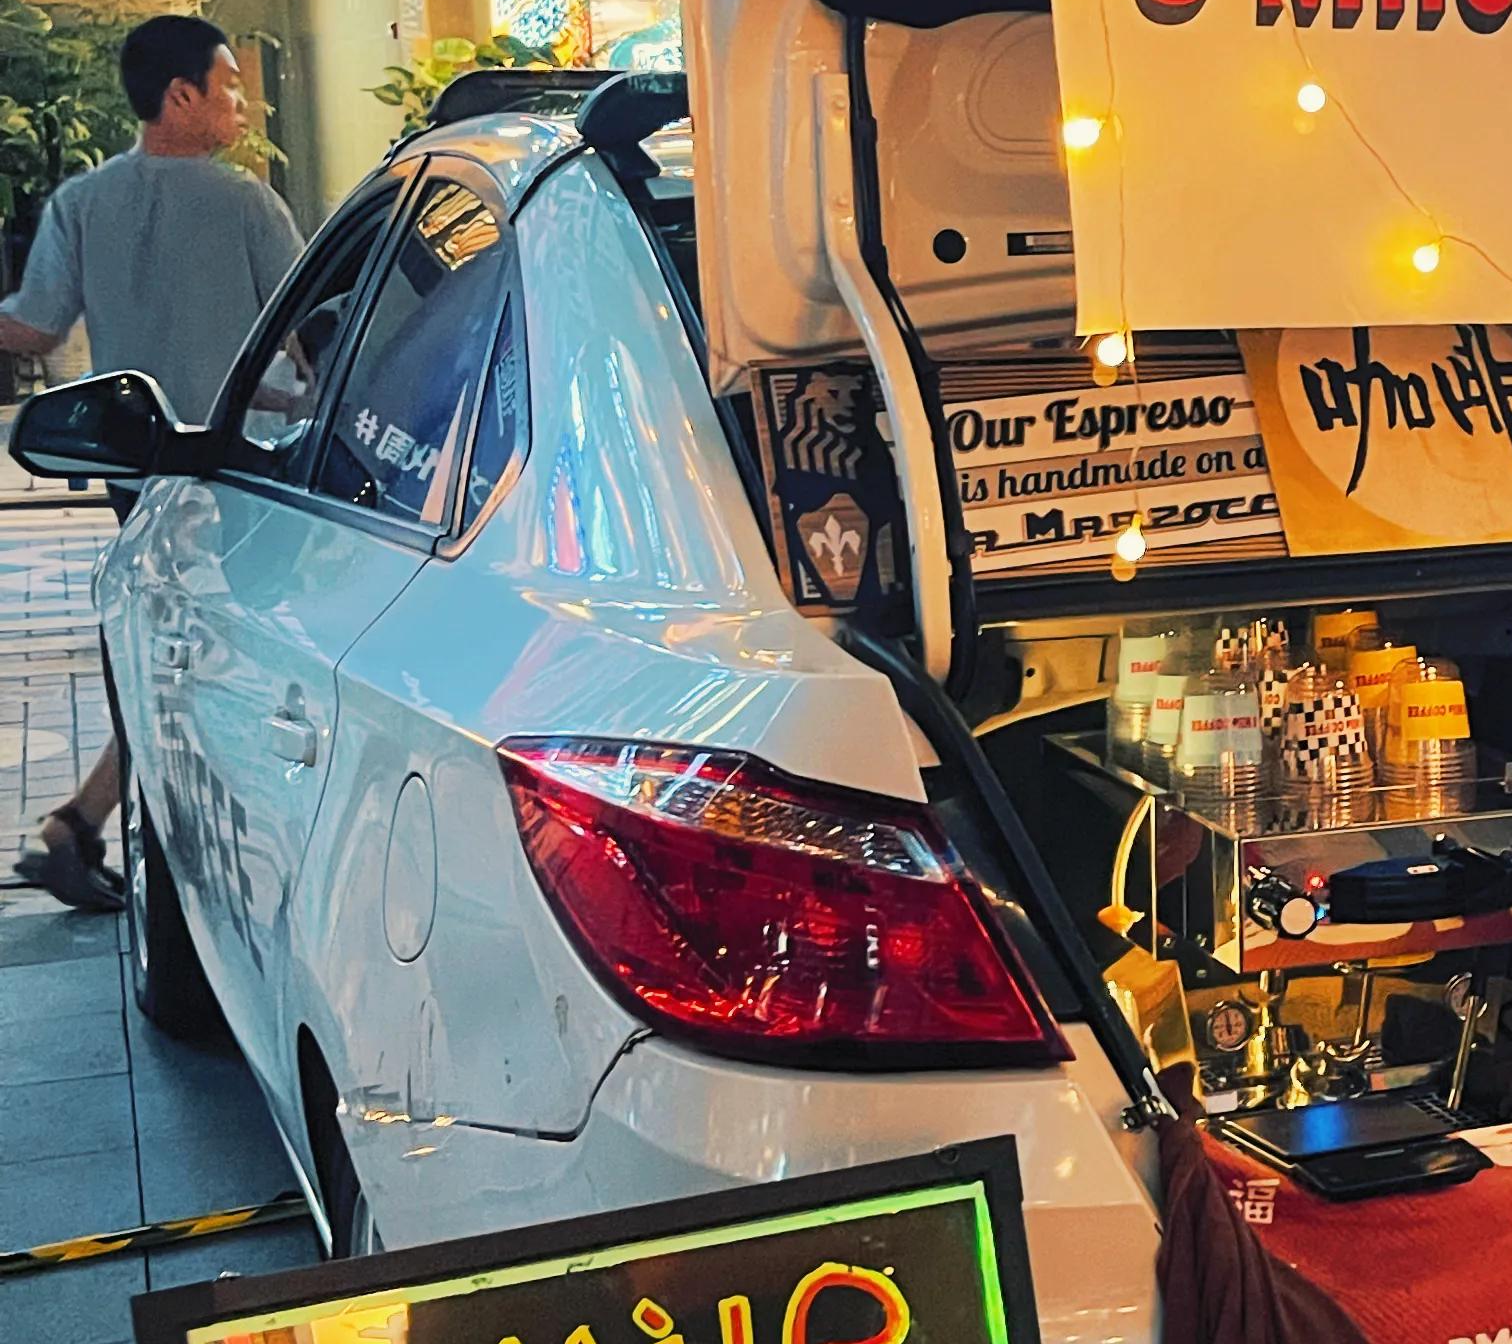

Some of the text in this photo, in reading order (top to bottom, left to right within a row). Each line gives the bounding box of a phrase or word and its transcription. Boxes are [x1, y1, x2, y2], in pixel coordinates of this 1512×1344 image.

[952, 394, 1236, 455] Our Espresso
[961, 446, 1267, 504] is handmade on a
